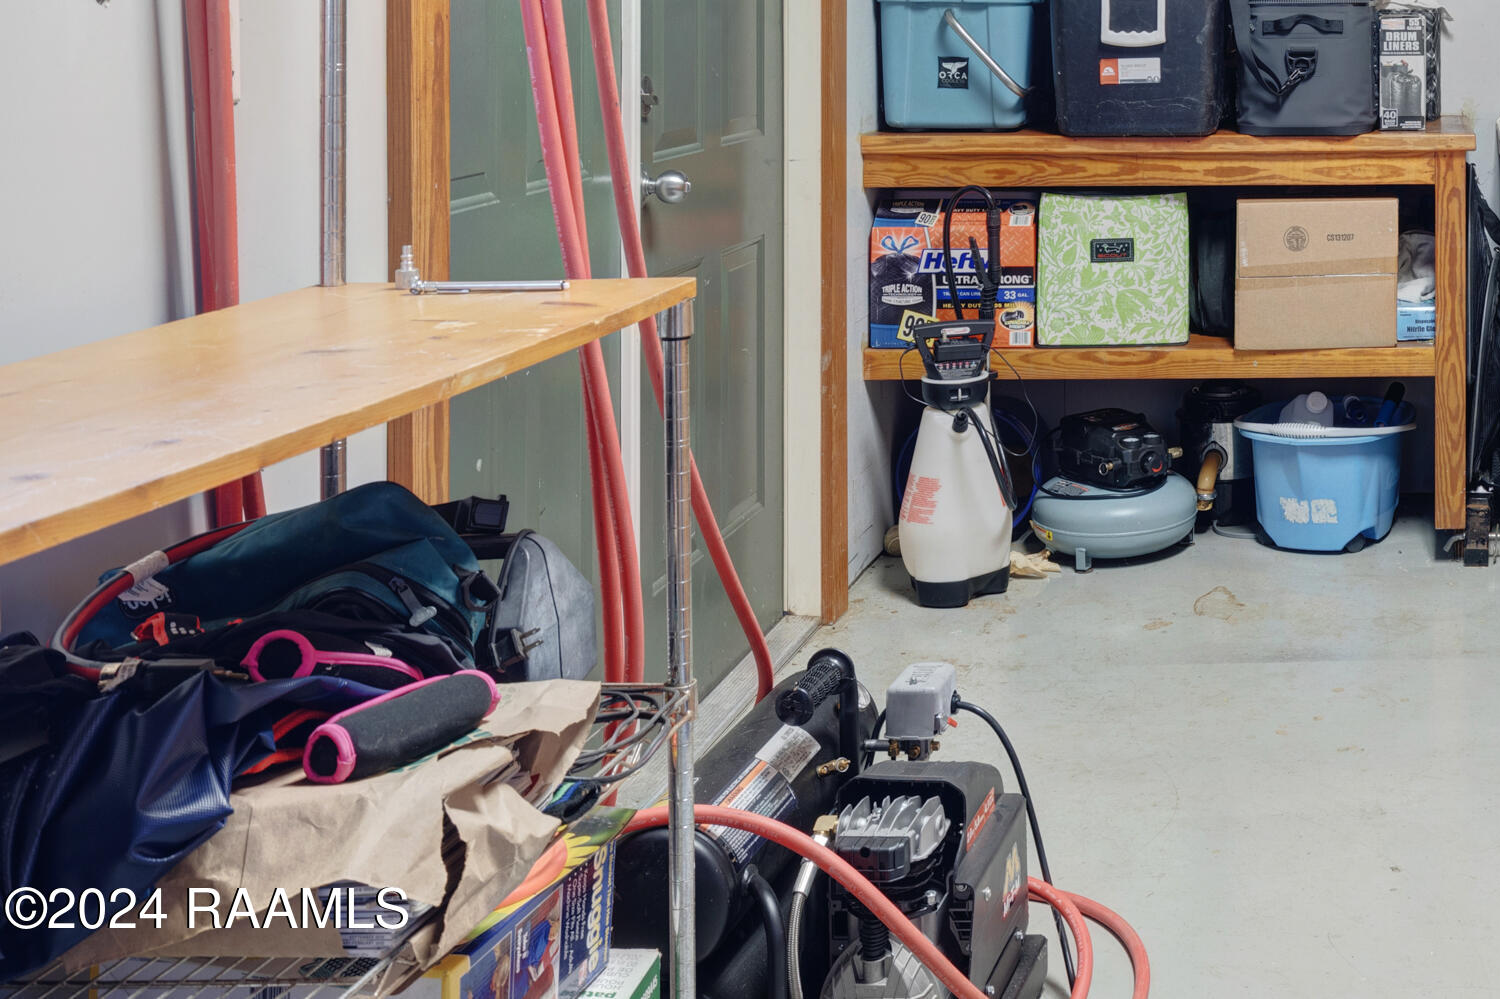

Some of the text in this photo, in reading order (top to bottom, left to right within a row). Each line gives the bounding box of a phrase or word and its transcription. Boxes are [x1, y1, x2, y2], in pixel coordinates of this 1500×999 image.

[1385, 32, 1418, 41] DRUM
[1383, 41, 1420, 51] LINERS
[938, 71, 968, 81] ORCA
[1384, 110, 1396, 120] 40
[918, 213, 931, 224] 90
[882, 282, 922, 293] TRIPLE ACTION
[1003, 290, 1017, 299] 33
[1407, 325, 1425, 333] Nitrile
[587, 847, 607, 973] Snuggie
